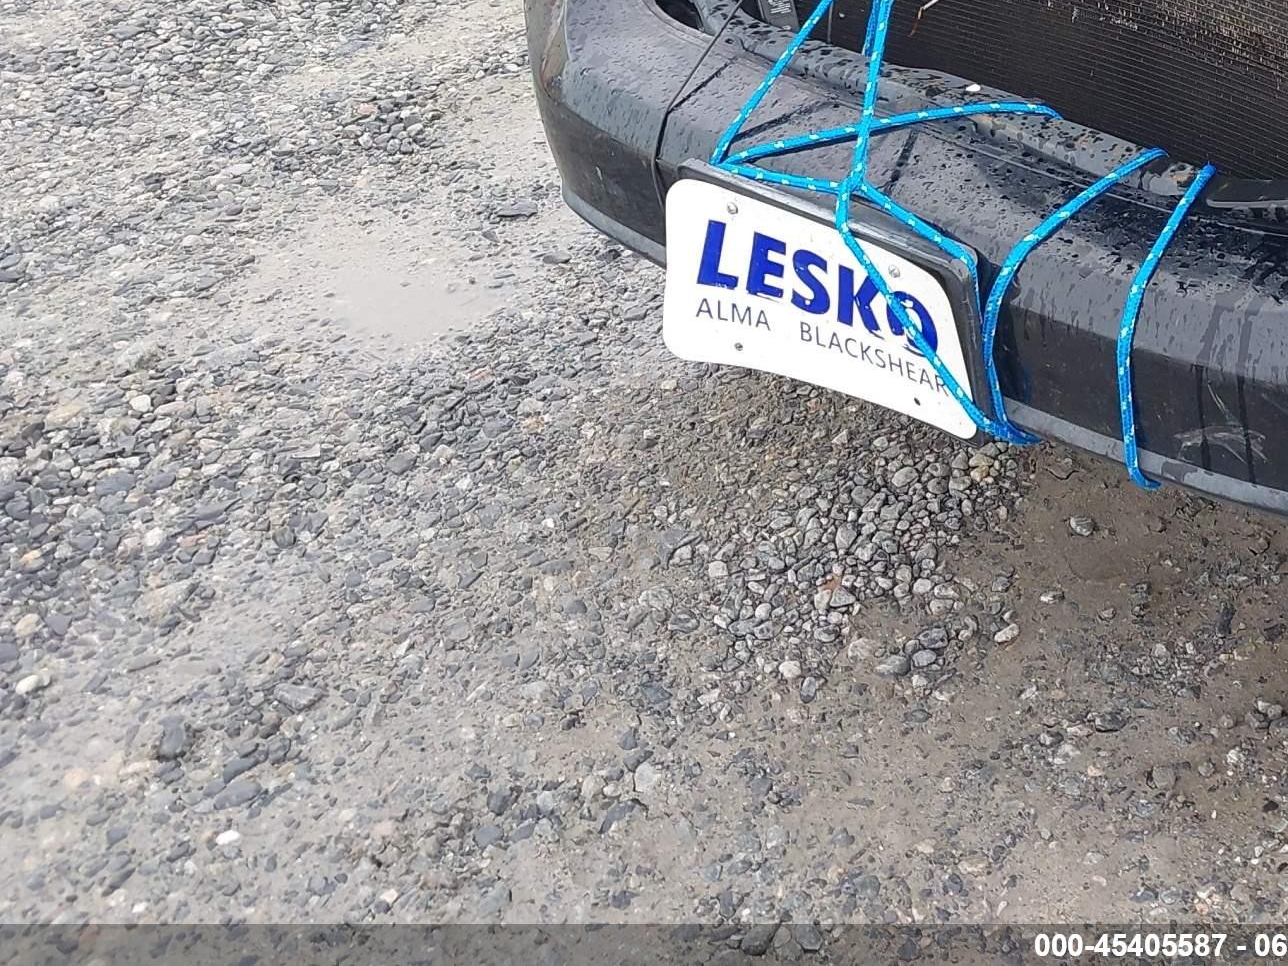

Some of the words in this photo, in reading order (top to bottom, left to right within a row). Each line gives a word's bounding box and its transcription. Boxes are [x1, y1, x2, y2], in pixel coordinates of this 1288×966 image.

[695, 297, 771, 331] ALMA
[800, 321, 950, 397] BLACKSHEAR
[696, 219, 938, 358] LESKO
